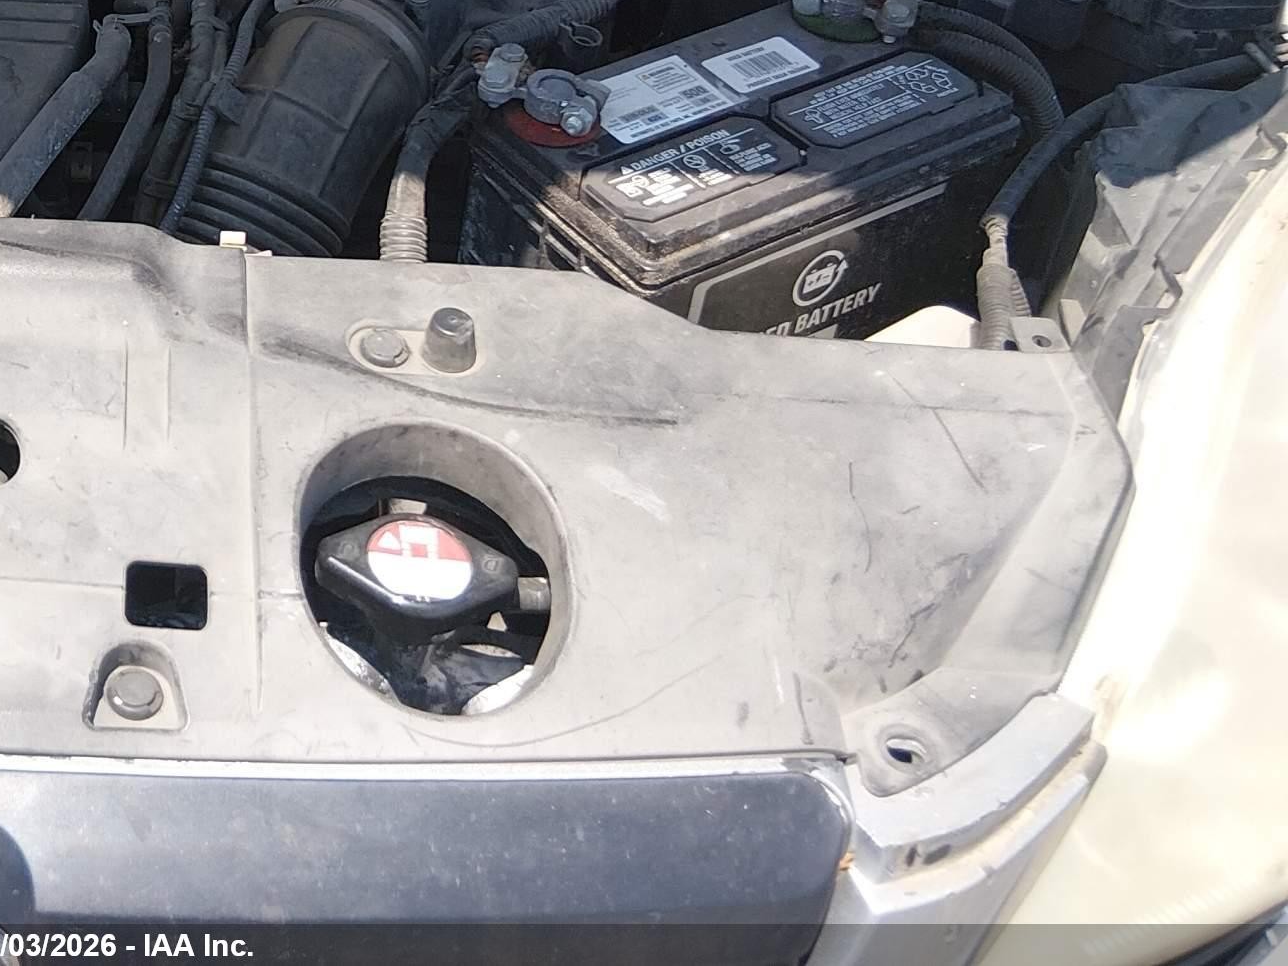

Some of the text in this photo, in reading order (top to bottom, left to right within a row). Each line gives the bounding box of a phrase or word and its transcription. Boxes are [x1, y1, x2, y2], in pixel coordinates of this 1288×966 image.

[630, 147, 680, 171] DANGER
[685, 129, 731, 150] POISON
[794, 283, 882, 334] BATTERY
